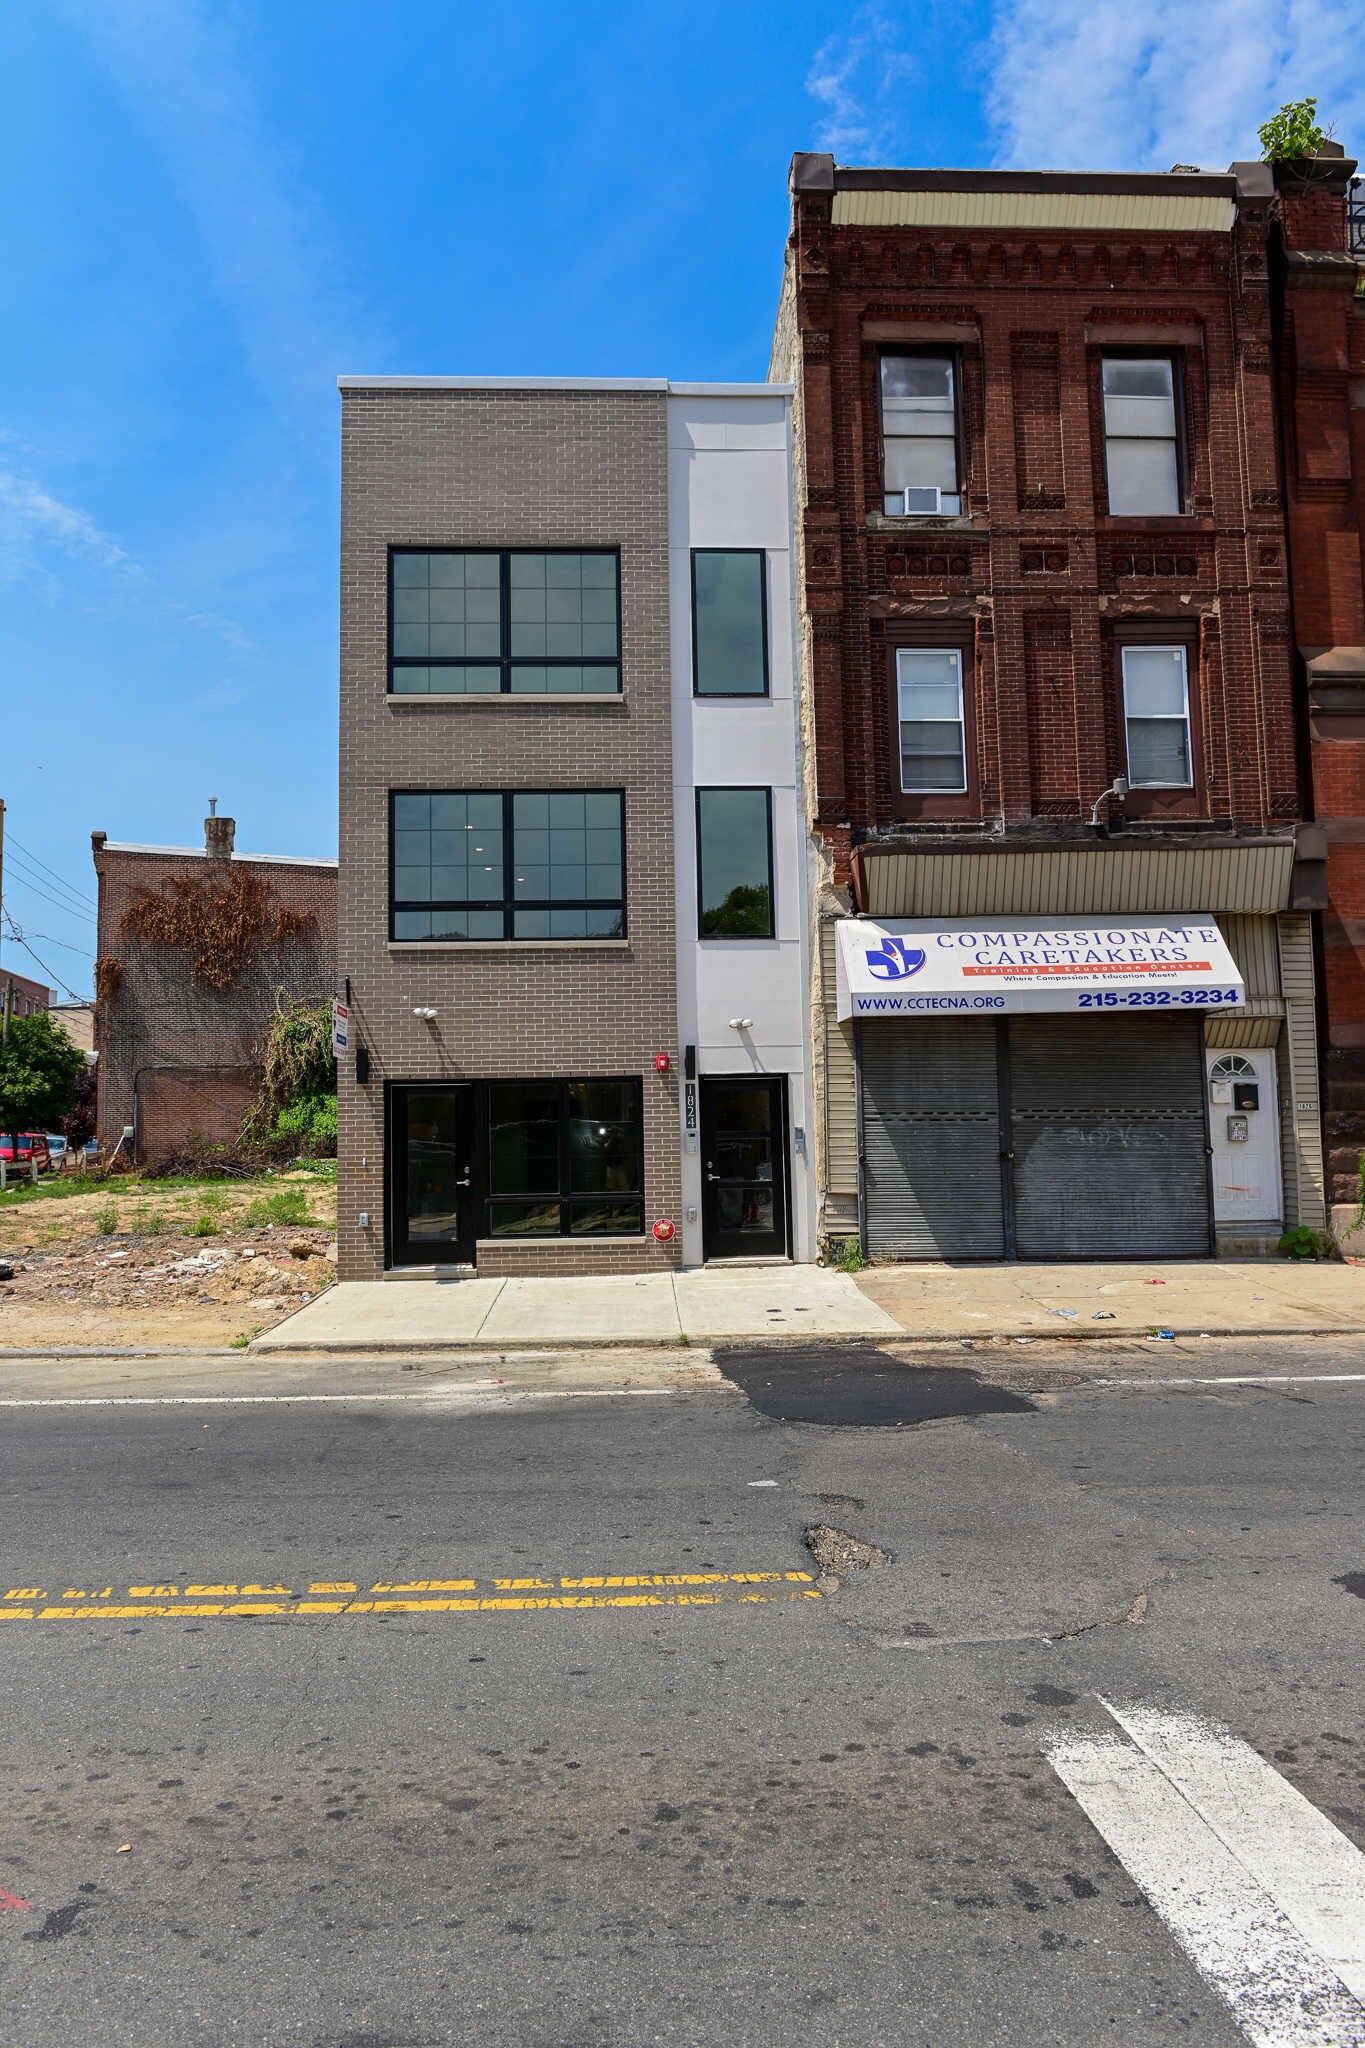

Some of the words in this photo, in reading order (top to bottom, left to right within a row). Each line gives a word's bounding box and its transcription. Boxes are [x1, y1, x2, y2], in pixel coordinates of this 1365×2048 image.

[937, 930, 1217, 947] COMPASSIONATE
[975, 948, 1188, 964] CARETAKERS
[1065, 964, 1142, 972] Education
[1150, 962, 1202, 970] Center
[858, 997, 1005, 1010] WWW.CCTECNA.ORG
[1078, 989, 1239, 1007] 215-232-3234
